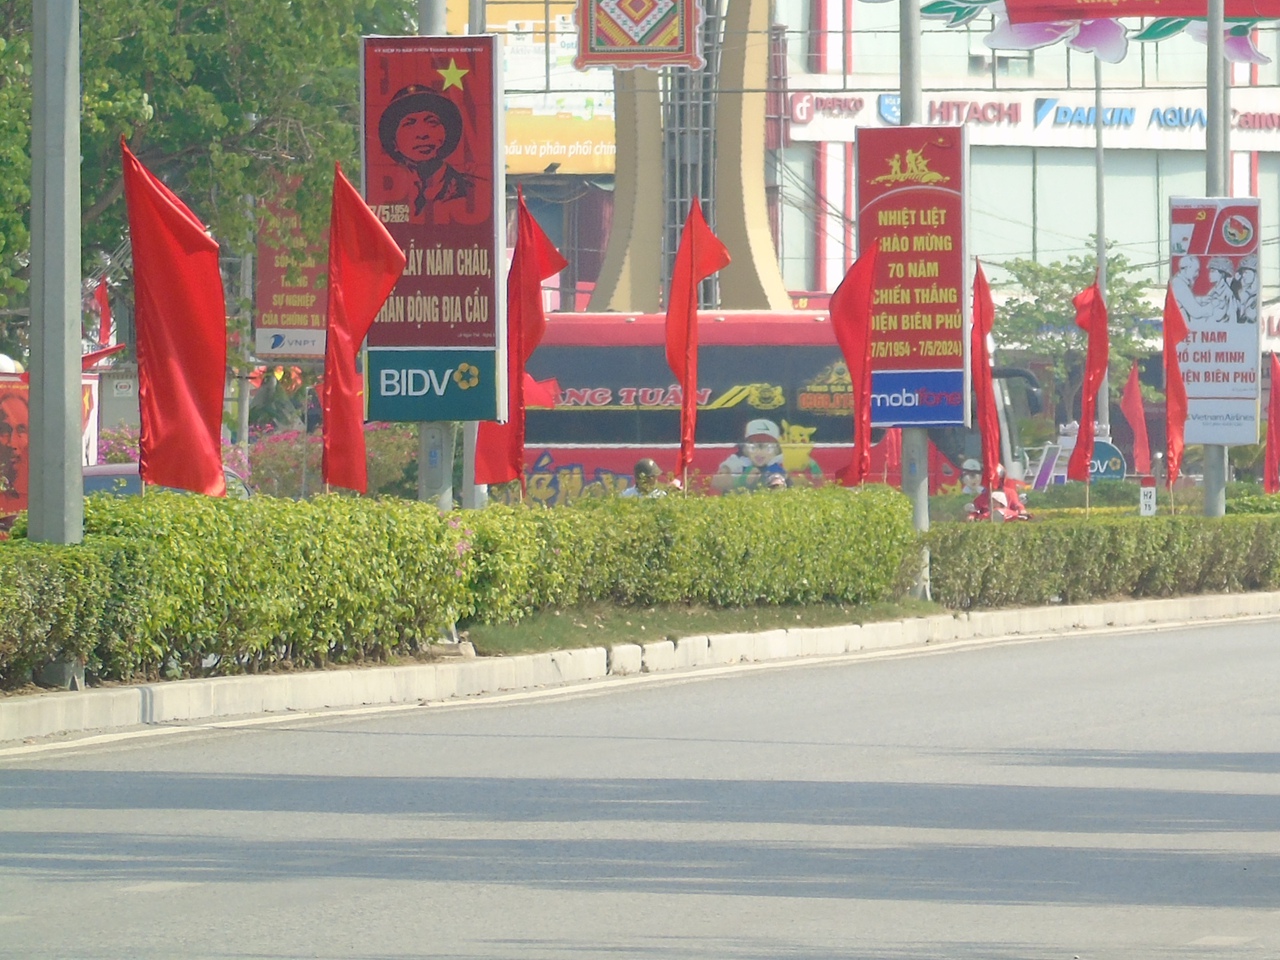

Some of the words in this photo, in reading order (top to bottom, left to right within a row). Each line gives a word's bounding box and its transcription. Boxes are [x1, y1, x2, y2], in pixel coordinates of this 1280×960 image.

[929, 100, 1023, 123] HITACHI
[1150, 106, 1208, 128] AQUA
[878, 207, 916, 229] NHIỆT
[920, 207, 946, 229] LIỆT
[912, 235, 952, 252] MỪNG
[426, 245, 454, 276] NĂM
[457, 243, 491, 279] CHÂU,
[888, 263, 905, 278] 70
[908, 261, 938, 278] NĂM
[286, 292, 316, 309] NGHIỆP
[872, 283, 911, 304] CHIẾN
[914, 283, 957, 304] THẮNG
[407, 290, 439, 329] ĐỘNG
[442, 296, 463, 329] ĐỊA
[465, 286, 488, 323] CẦU
[262, 312, 279, 326] CỦA
[902, 311, 933, 330] BIÊN
[936, 309, 962, 330] PHỦ
[287, 339, 316, 347] VNPT
[1201, 331, 1228, 344] NAM
[1193, 350, 1211, 364] CHÍ
[1215, 351, 1245, 364] MINH
[380, 368, 453, 397] BIDV
[1204, 368, 1230, 383] BIÊN
[1233, 367, 1256, 384] PHỦ
[870, 388, 962, 408] mobifone
[1191, 413, 1224, 421] Vietnam
